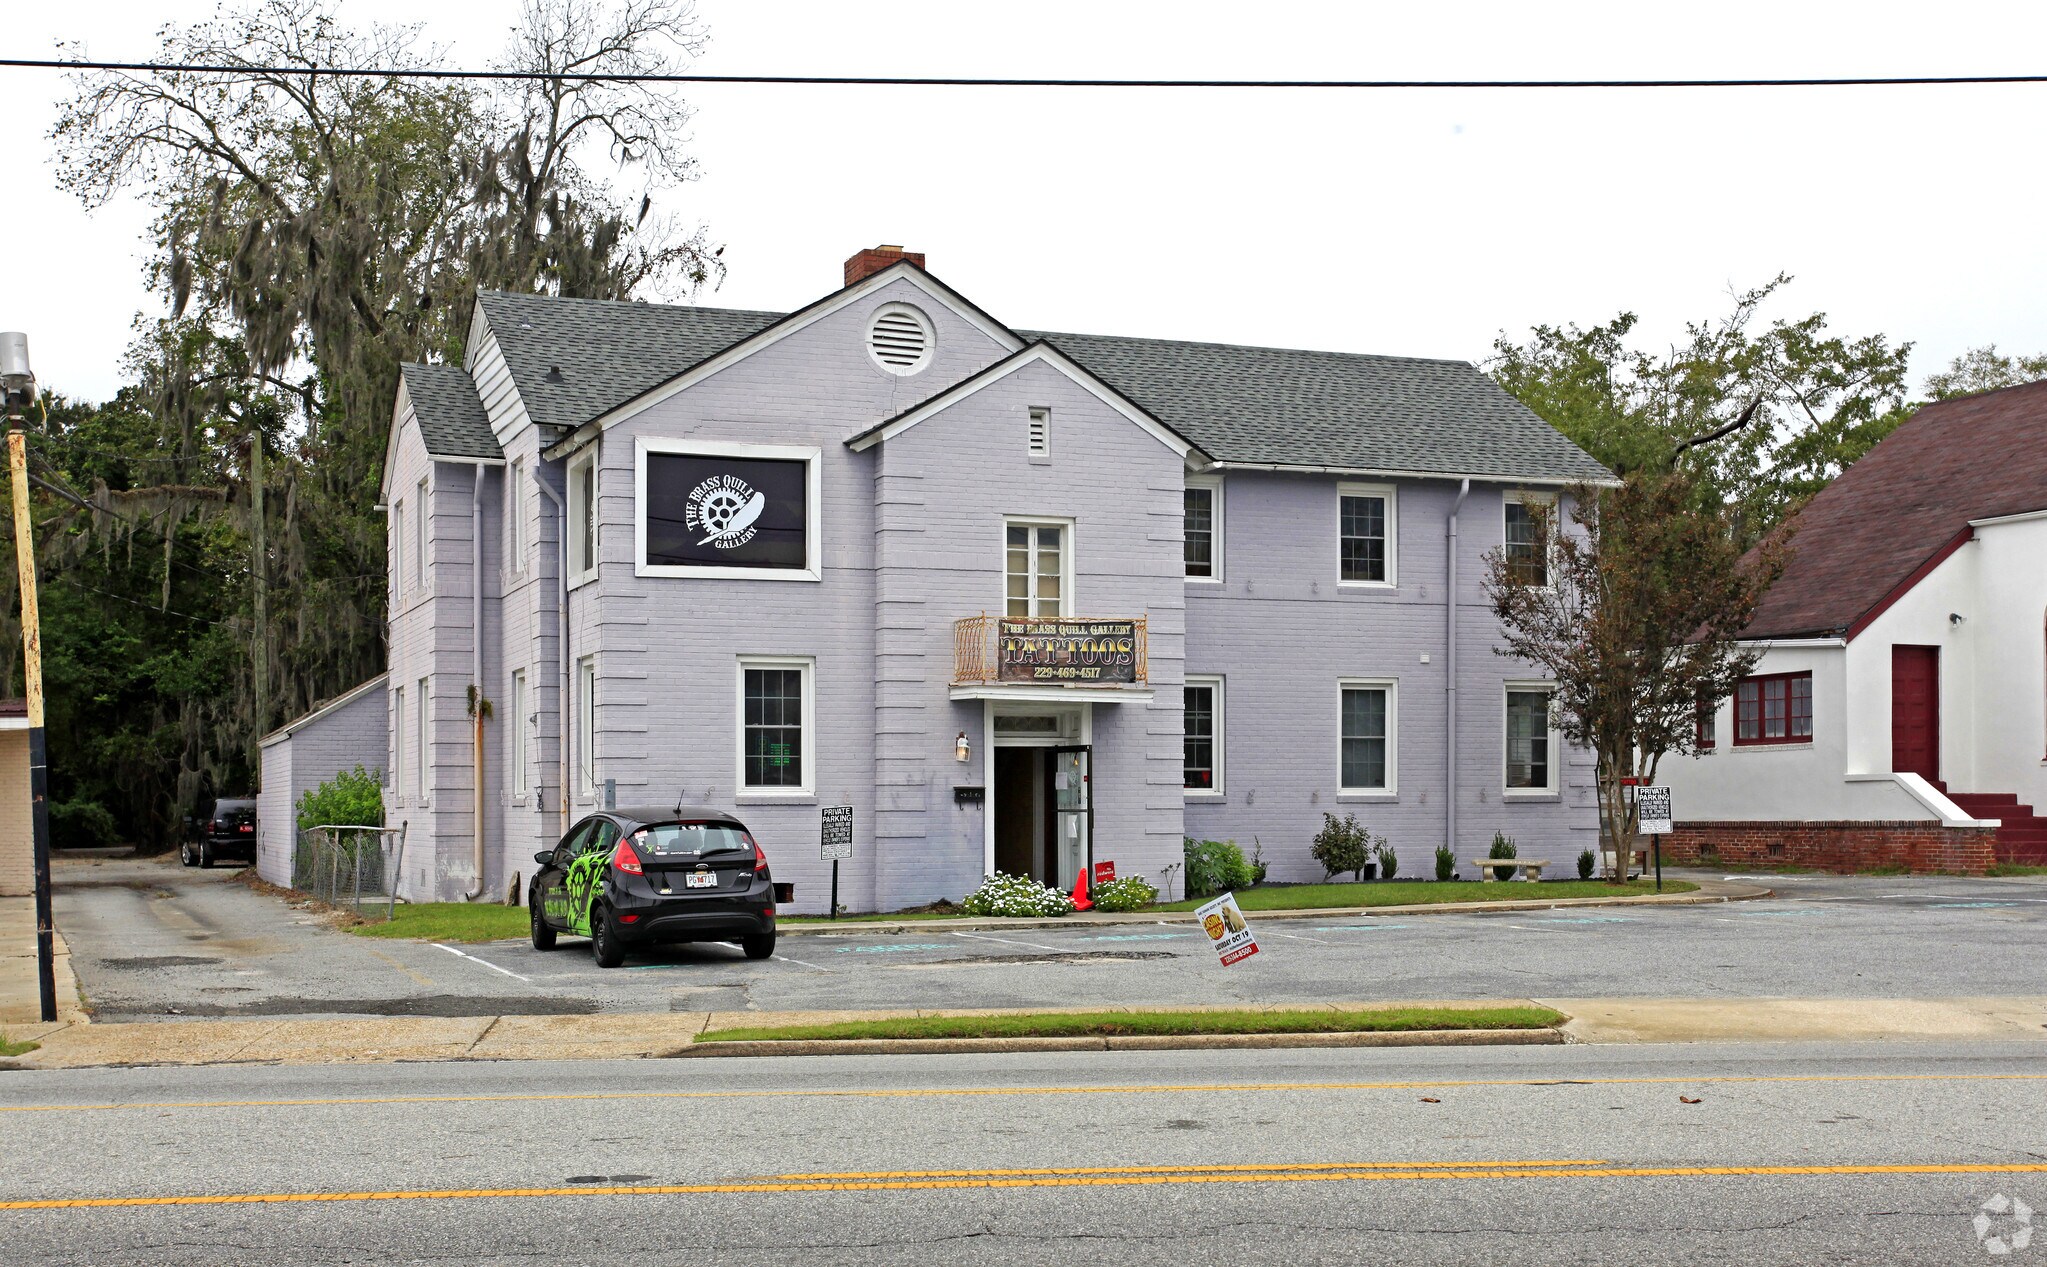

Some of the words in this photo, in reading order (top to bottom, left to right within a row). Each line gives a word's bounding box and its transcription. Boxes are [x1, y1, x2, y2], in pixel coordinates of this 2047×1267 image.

[688, 475, 721, 503] BRASS
[722, 474, 756, 499] QUILL
[686, 502, 699, 532] THE
[715, 525, 758, 548] GALLERY
[1002, 623, 1024, 634] THE
[1026, 624, 1056, 635] BRASS
[1058, 624, 1088, 637] QUILL
[1090, 624, 1132, 635] GALLERY
[1001, 637, 1133, 666] TATTOOS
[823, 815, 851, 823] PARKING
[1231, 934, 1241, 943] OCT
